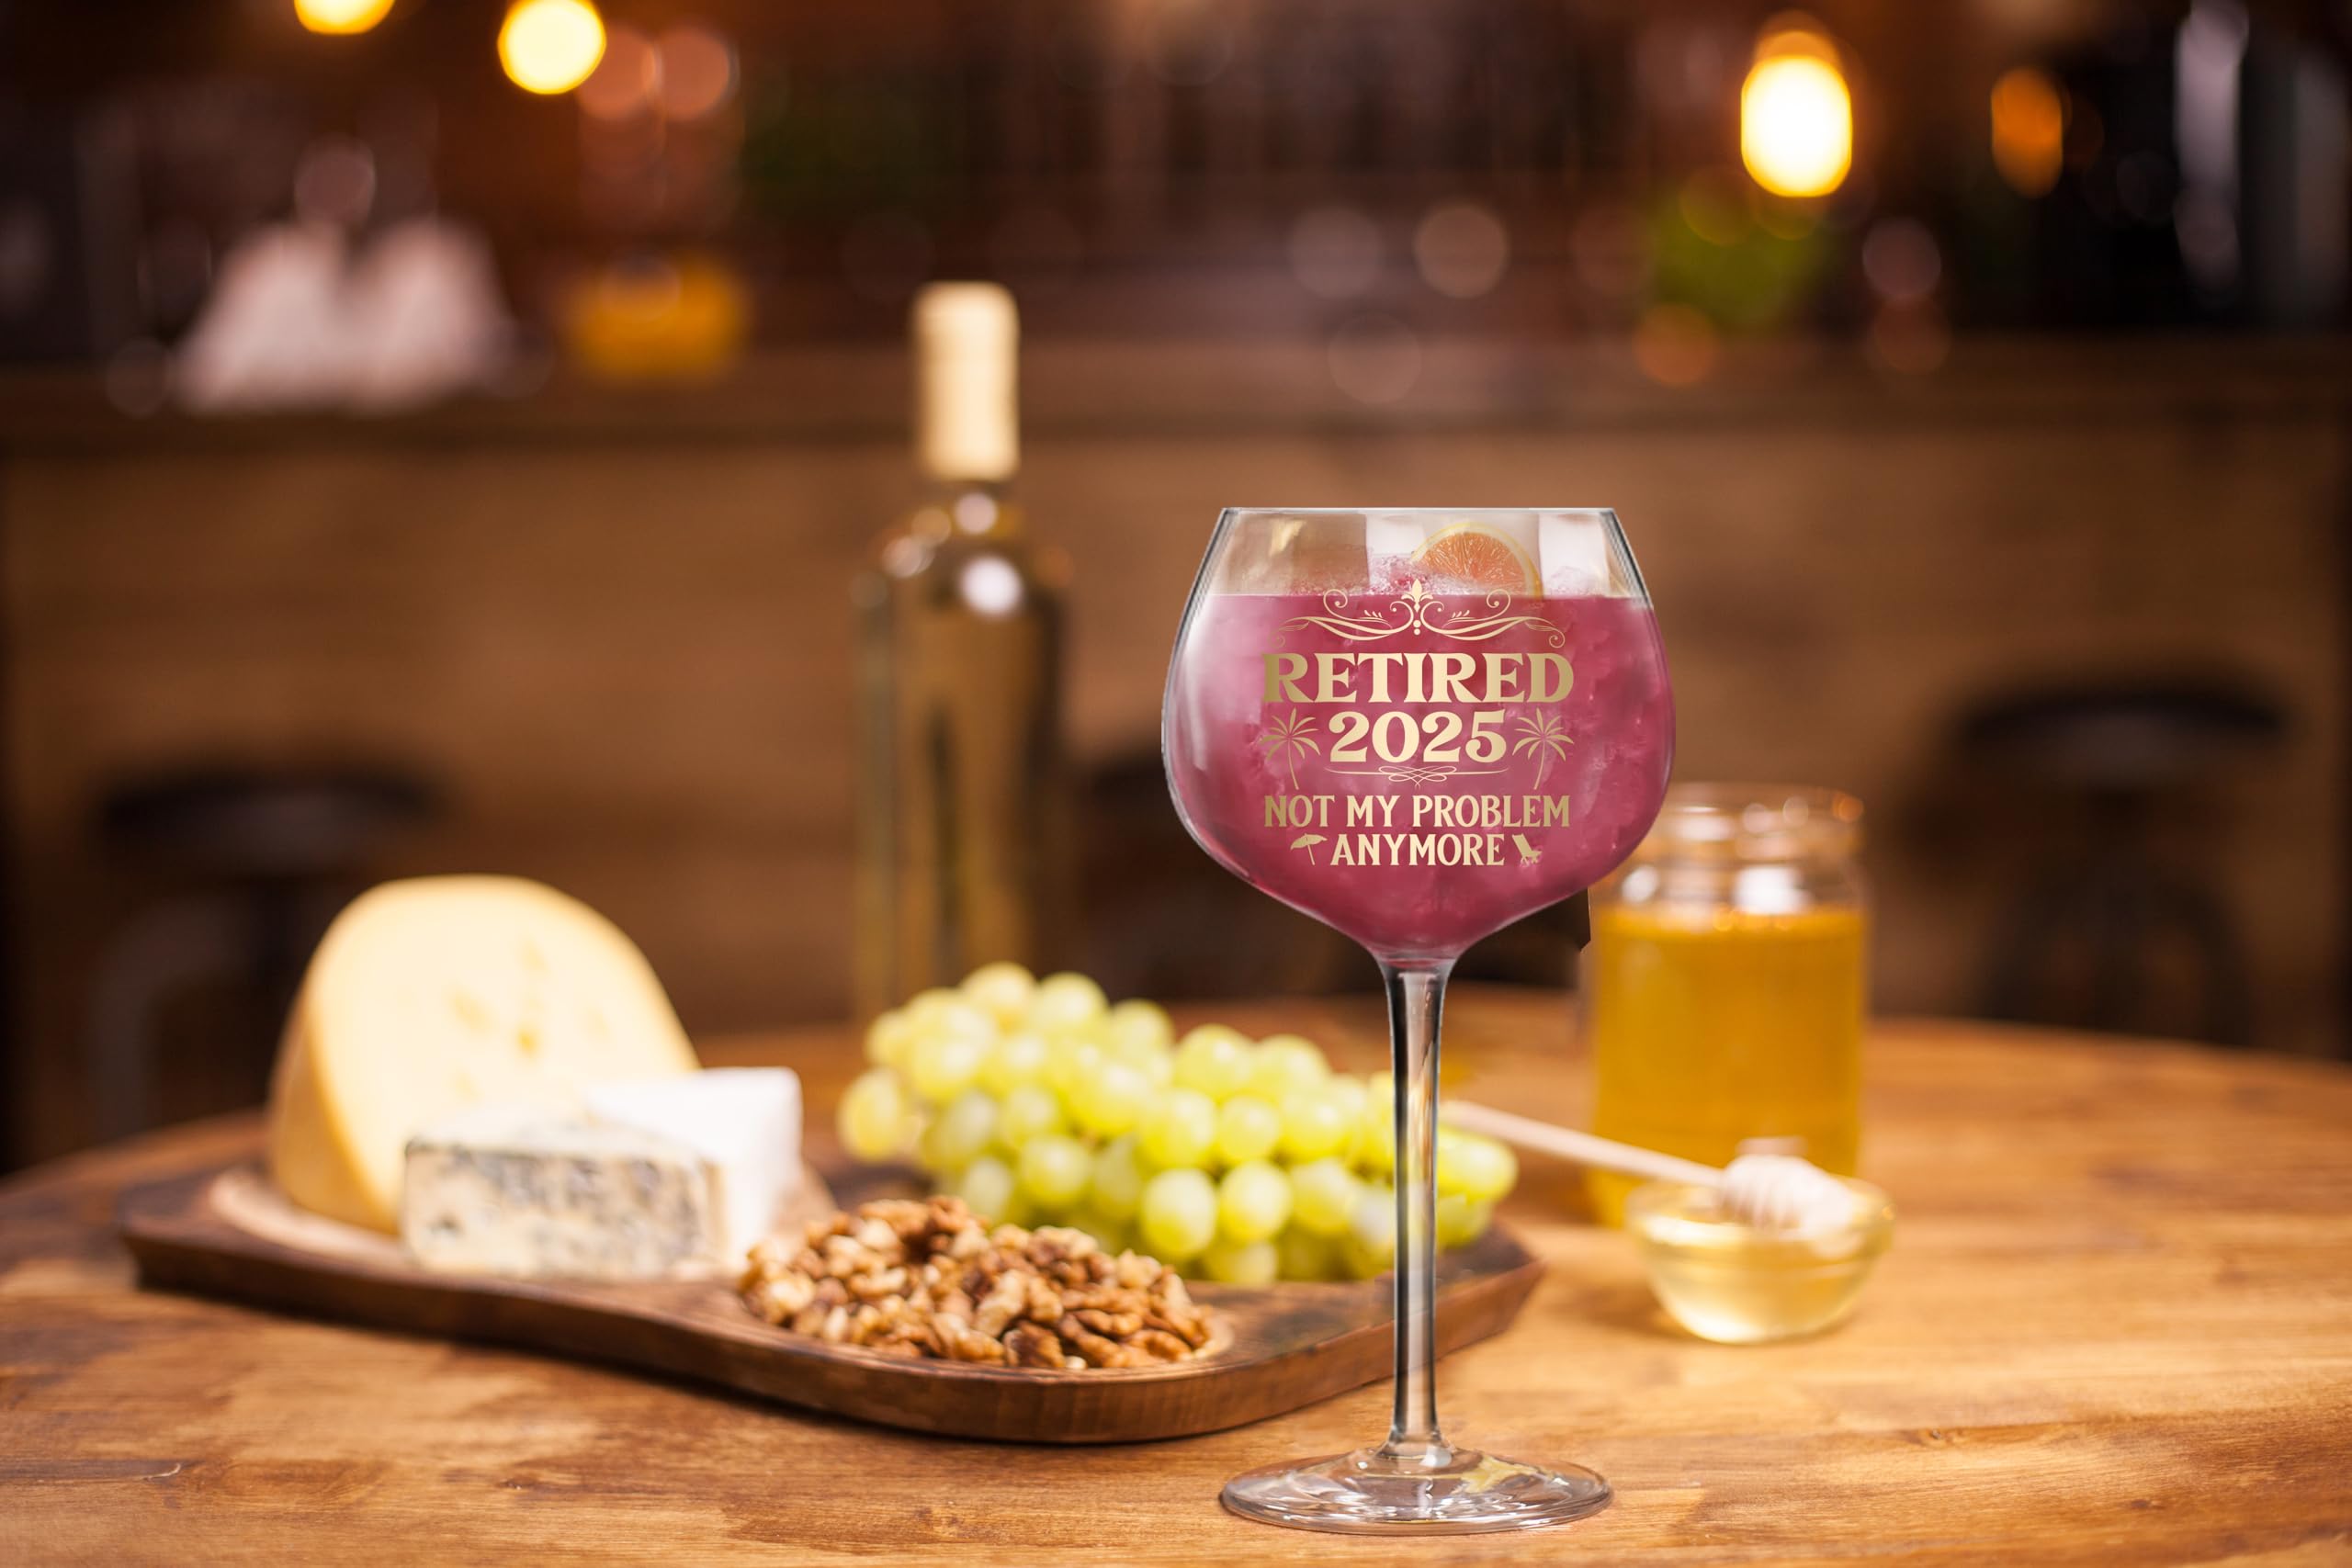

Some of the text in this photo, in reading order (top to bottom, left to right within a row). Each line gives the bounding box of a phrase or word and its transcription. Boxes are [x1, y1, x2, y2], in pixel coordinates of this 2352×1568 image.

[1261, 652, 1575, 703] RETIRED
[1328, 708, 1507, 762] 2025
[1263, 795, 1571, 827] NOT MY PROBLEM
[1329, 833, 1506, 866] ANYMORE
